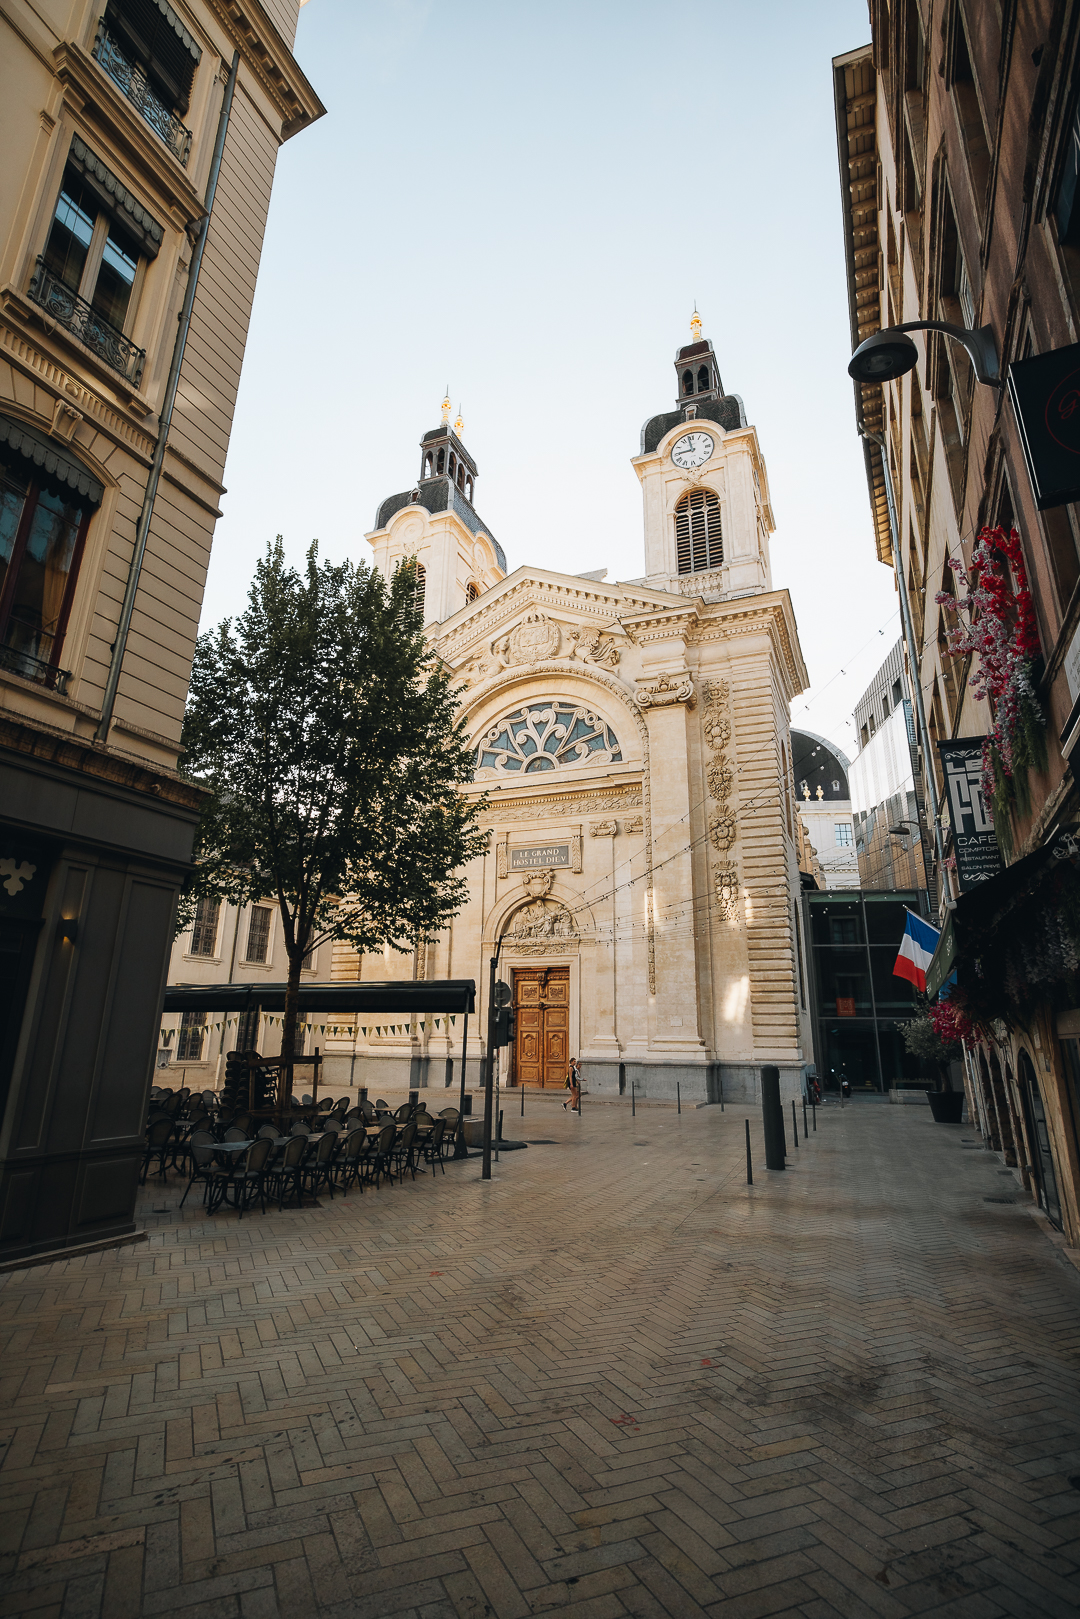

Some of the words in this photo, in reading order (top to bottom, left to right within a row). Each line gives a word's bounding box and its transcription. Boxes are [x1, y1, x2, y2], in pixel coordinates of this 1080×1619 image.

[957, 834, 997, 845] CAFÉ
[532, 848, 559, 856] GRAND
[513, 858, 543, 866] HOSTEL
